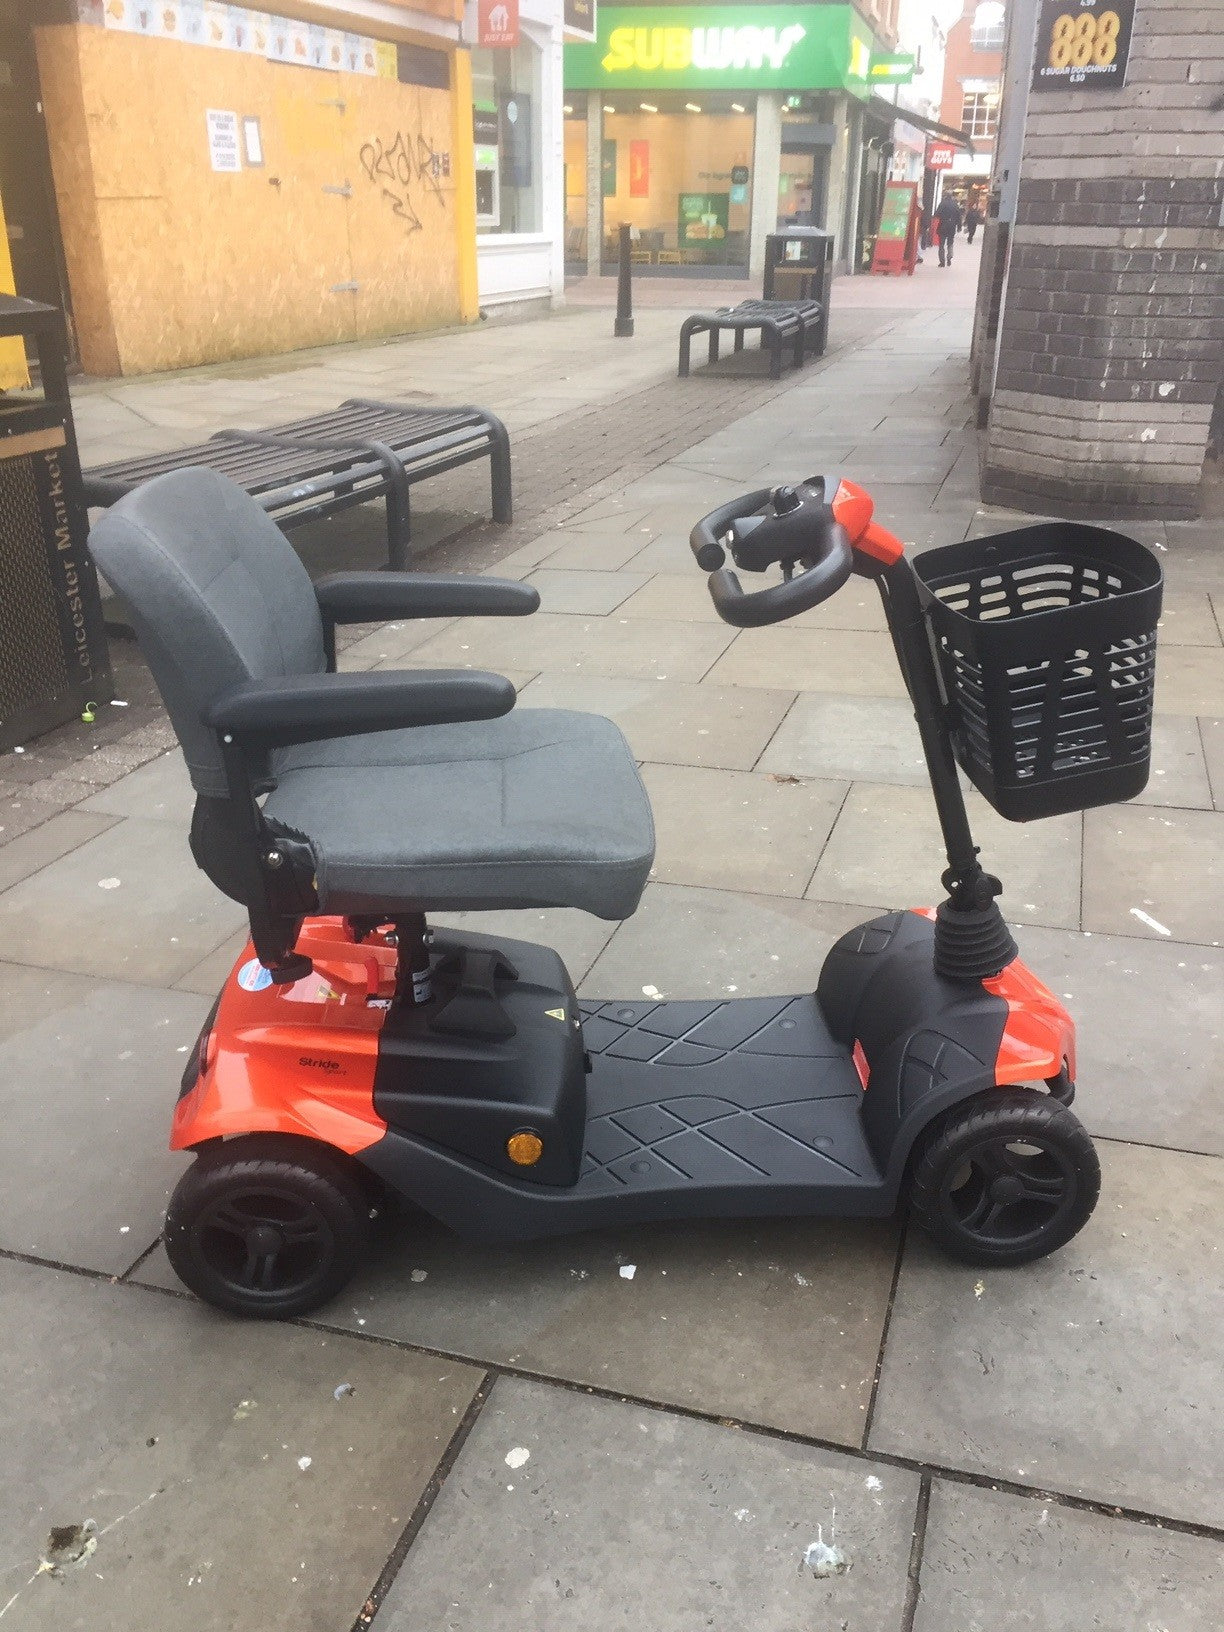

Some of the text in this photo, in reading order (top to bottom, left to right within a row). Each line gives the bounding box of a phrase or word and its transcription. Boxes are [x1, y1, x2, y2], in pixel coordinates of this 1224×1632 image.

[601, 23, 807, 72] SUBWAY
[1040, 64, 1117, 76] 6 SUGAR DOUGHNUTS
[45, 451, 93, 684] Leicester Market
[298, 1057, 340, 1069] Stride
